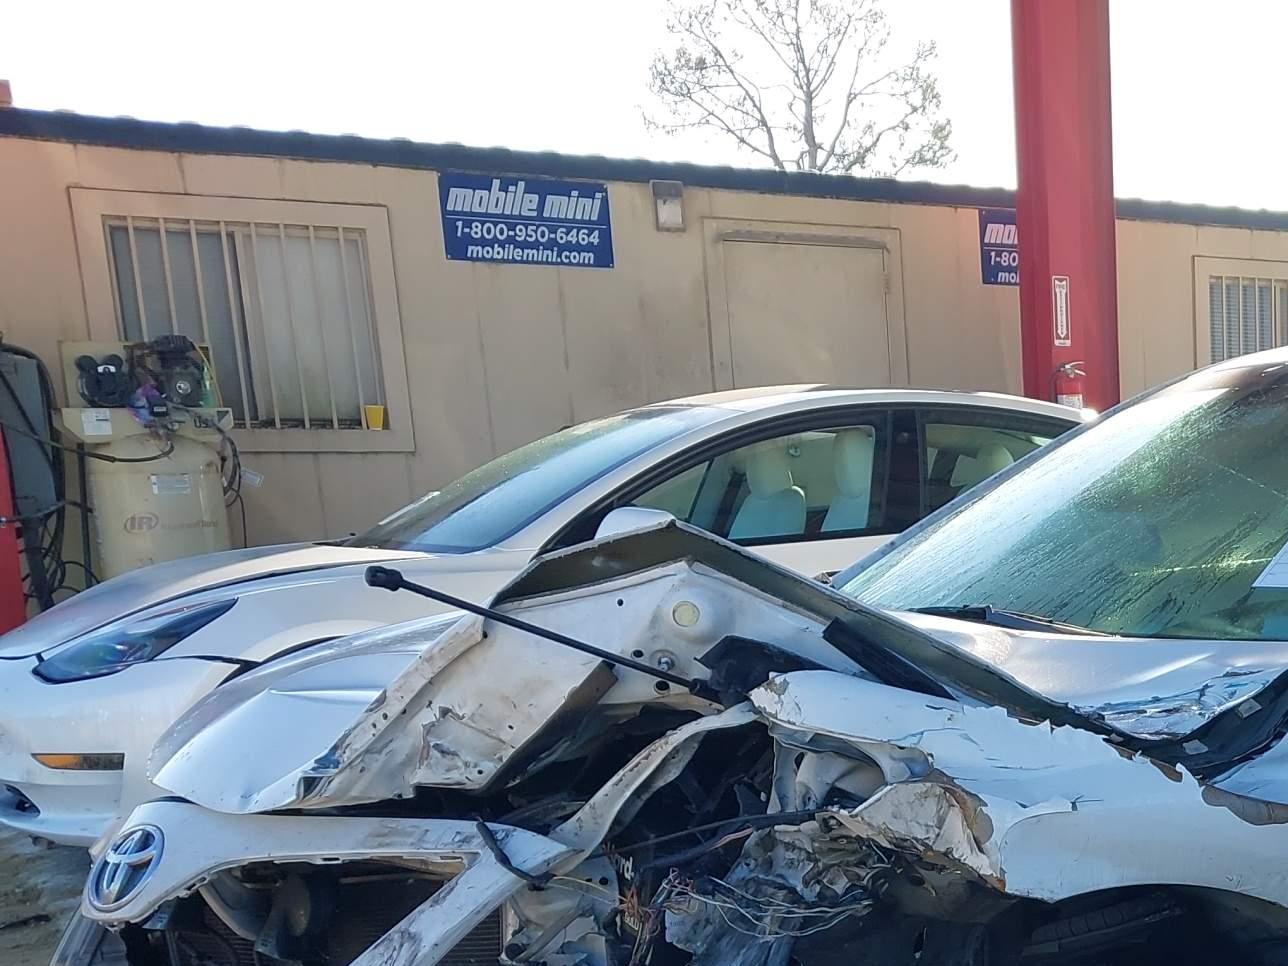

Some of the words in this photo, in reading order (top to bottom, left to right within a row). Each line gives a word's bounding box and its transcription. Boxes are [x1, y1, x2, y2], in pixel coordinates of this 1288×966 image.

[446, 178, 539, 217] mobile
[542, 190, 602, 221] mini
[455, 220, 600, 246] 1-800-950-6464
[466, 243, 594, 265] mobilemini.com
